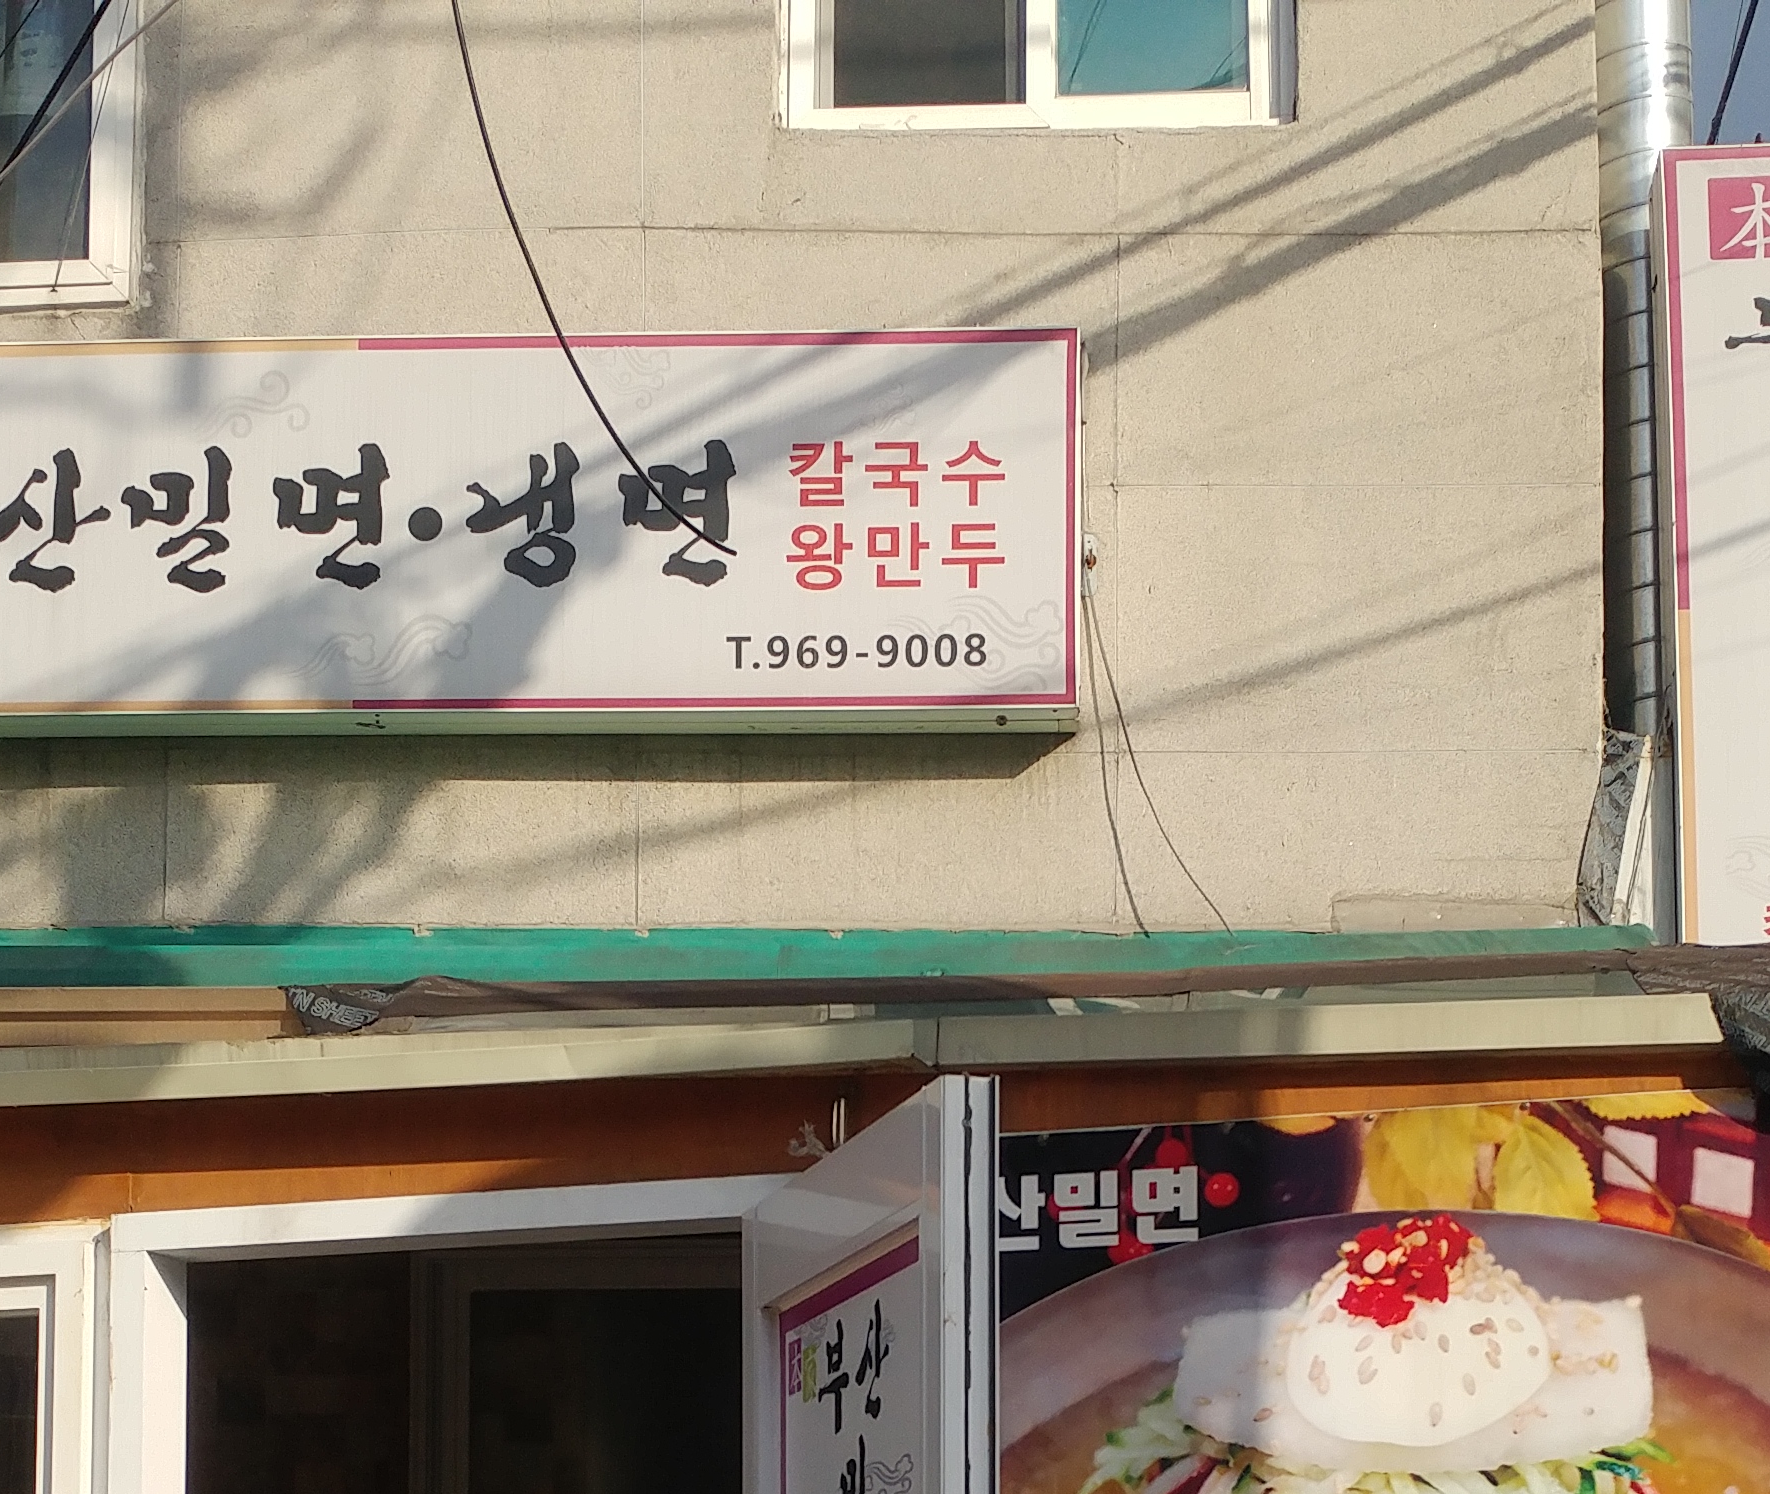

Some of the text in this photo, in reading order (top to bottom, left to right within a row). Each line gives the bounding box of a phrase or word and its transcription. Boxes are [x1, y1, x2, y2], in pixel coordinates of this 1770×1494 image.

[789, 438, 1008, 504] 칼국수
[785, 520, 1007, 592] 왕만두
[726, 633, 990, 671] T.969-9008
